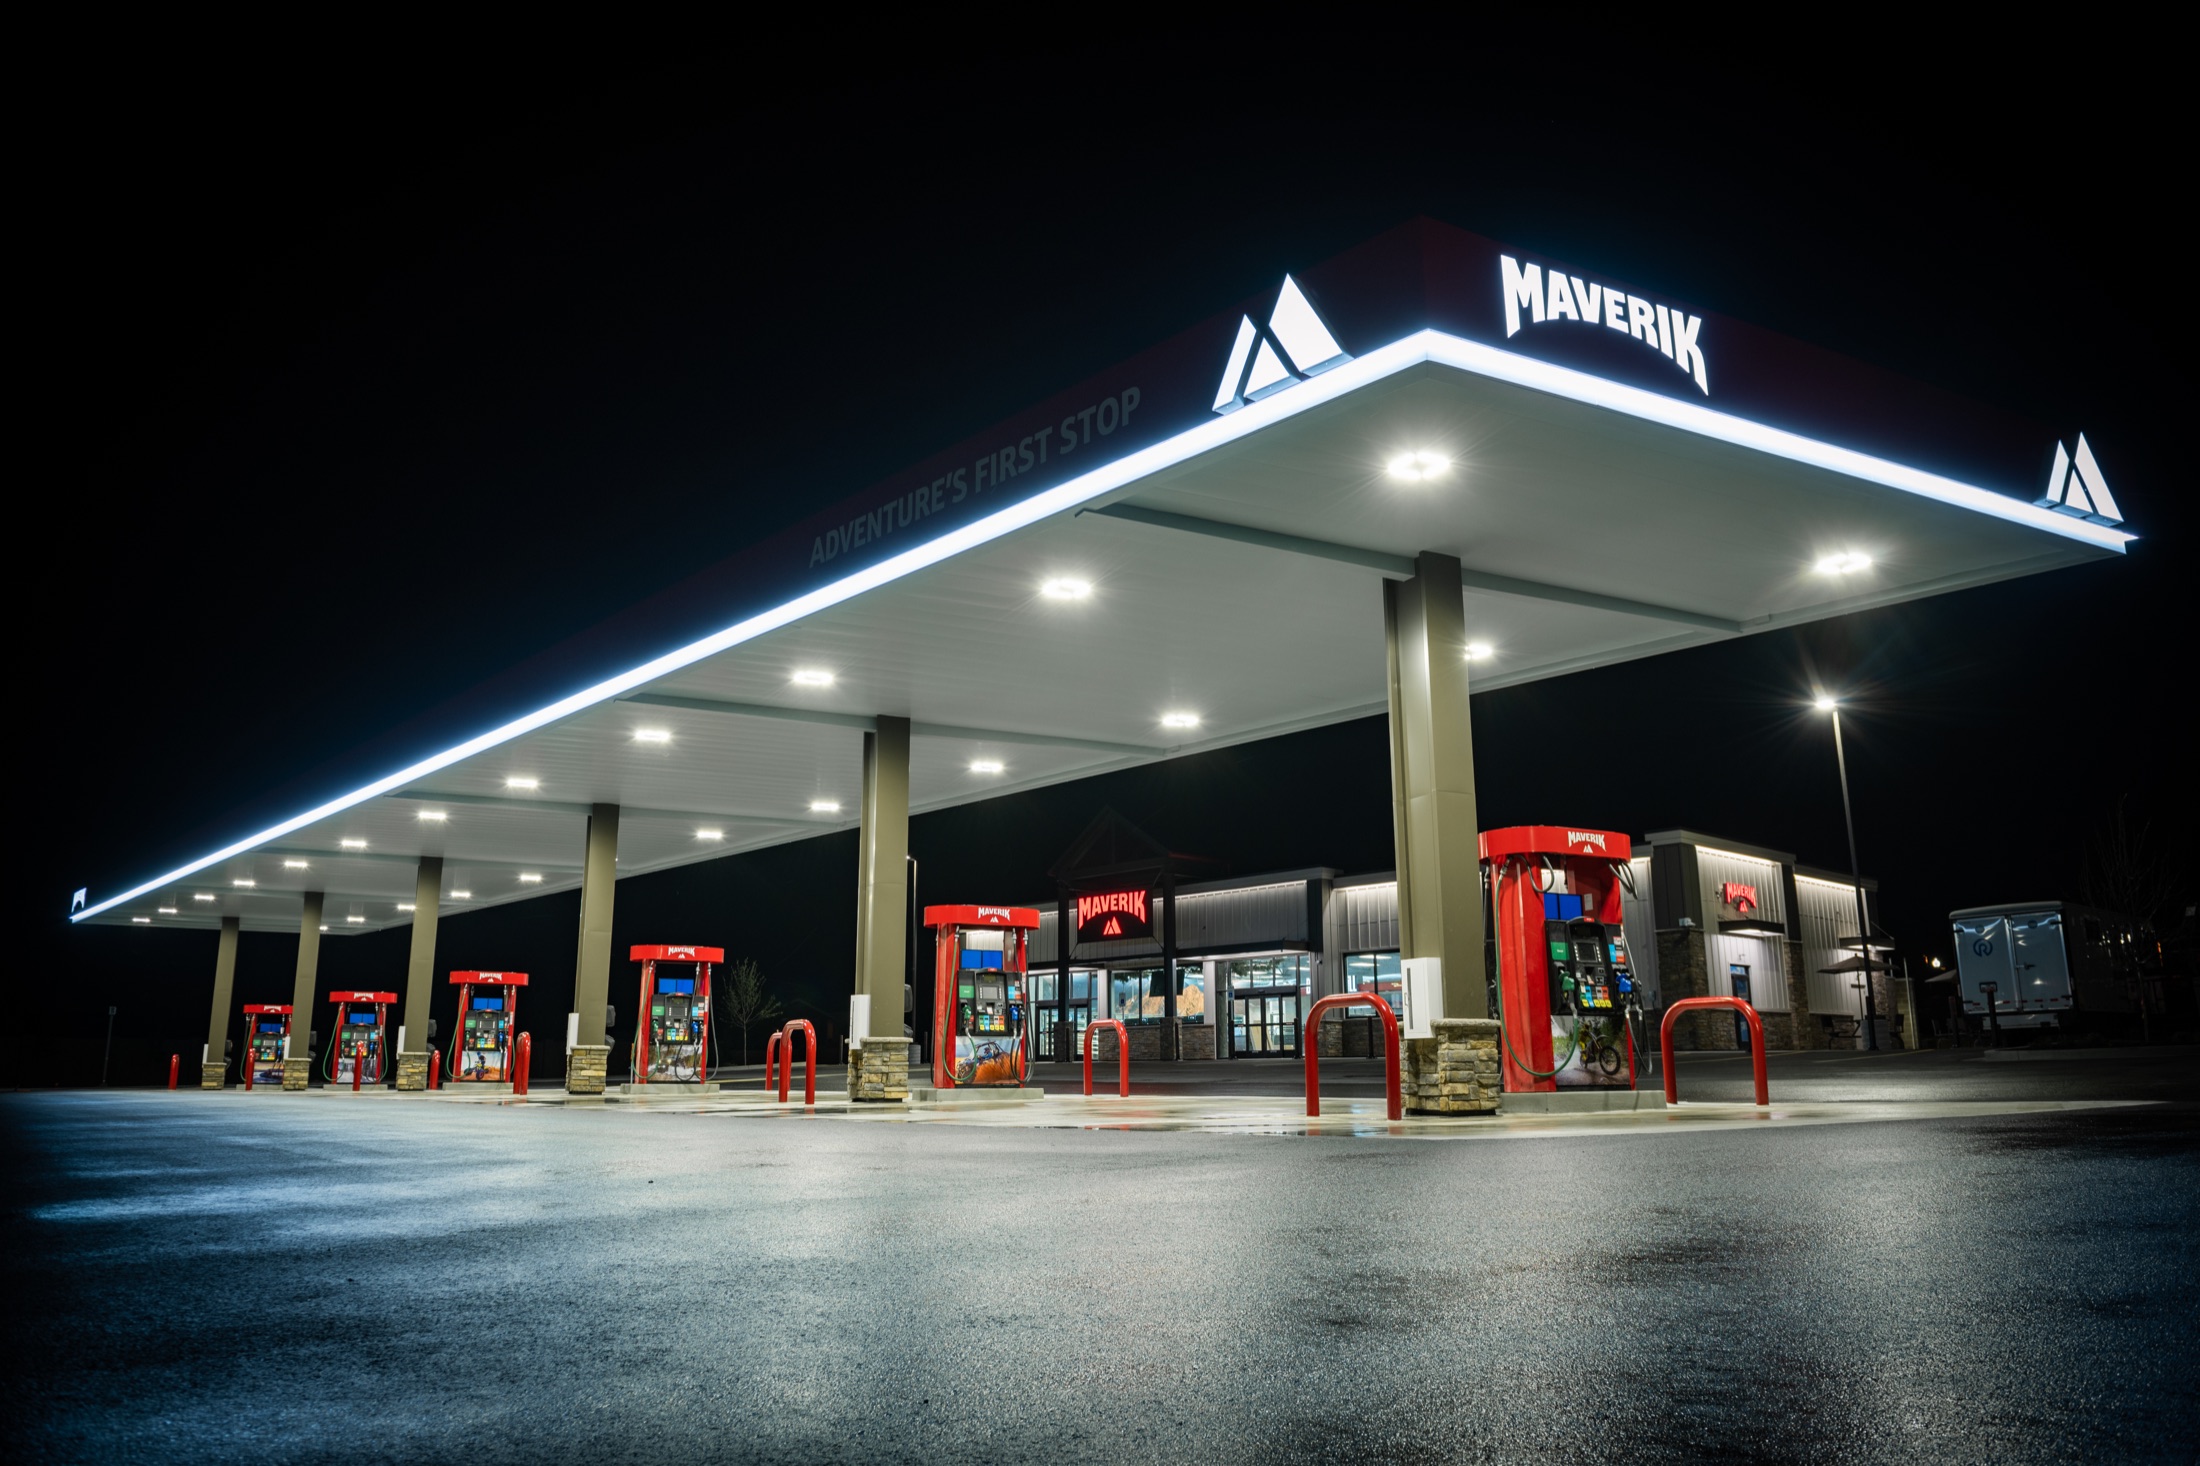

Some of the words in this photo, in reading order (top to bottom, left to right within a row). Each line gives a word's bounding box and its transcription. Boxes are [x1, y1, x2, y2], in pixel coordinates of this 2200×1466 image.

[1500, 253, 1709, 395] MAVERIK
[808, 467, 968, 567] ADVENTURE'S
[975, 426, 1053, 494] FIRST
[1059, 386, 1141, 455] STOP
[1567, 831, 1606, 851] MAVERIK
[1726, 882, 1757, 908] MAVERIK
[978, 907, 1011, 921] MAVERIK
[1077, 890, 1146, 929] MAVERIK
[668, 946, 695, 957] MAVERIK
